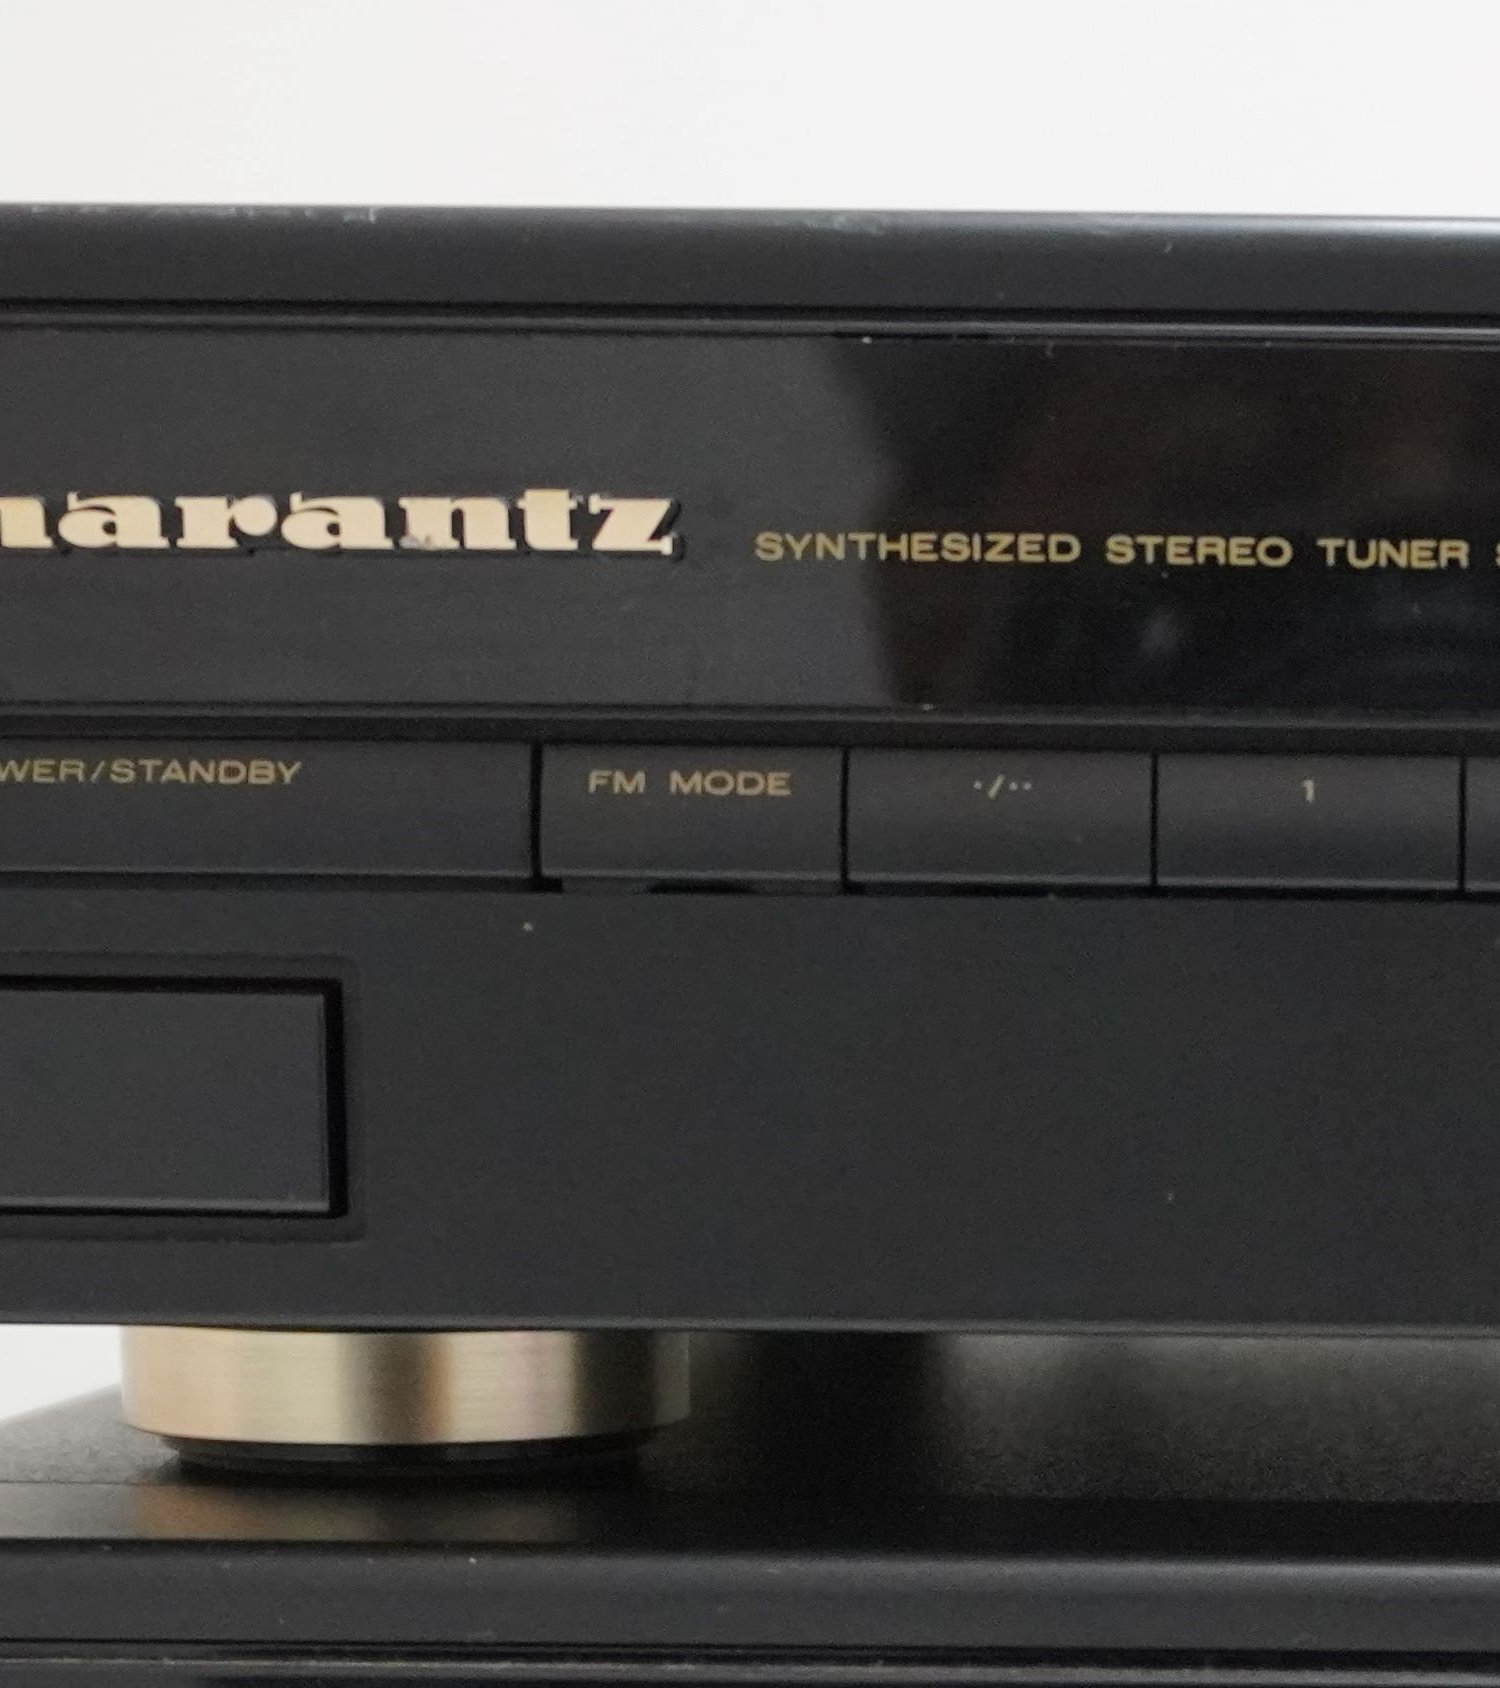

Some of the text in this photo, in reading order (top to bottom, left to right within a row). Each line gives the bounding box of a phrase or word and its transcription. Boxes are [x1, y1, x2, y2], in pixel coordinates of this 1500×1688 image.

[754, 530, 1081, 563] SYNTHESIZED
[1105, 534, 1293, 567] STEREO
[1316, 537, 1470, 569] TUNER
[588, 769, 791, 797] FM MODE
[1302, 779, 1315, 802] 1
